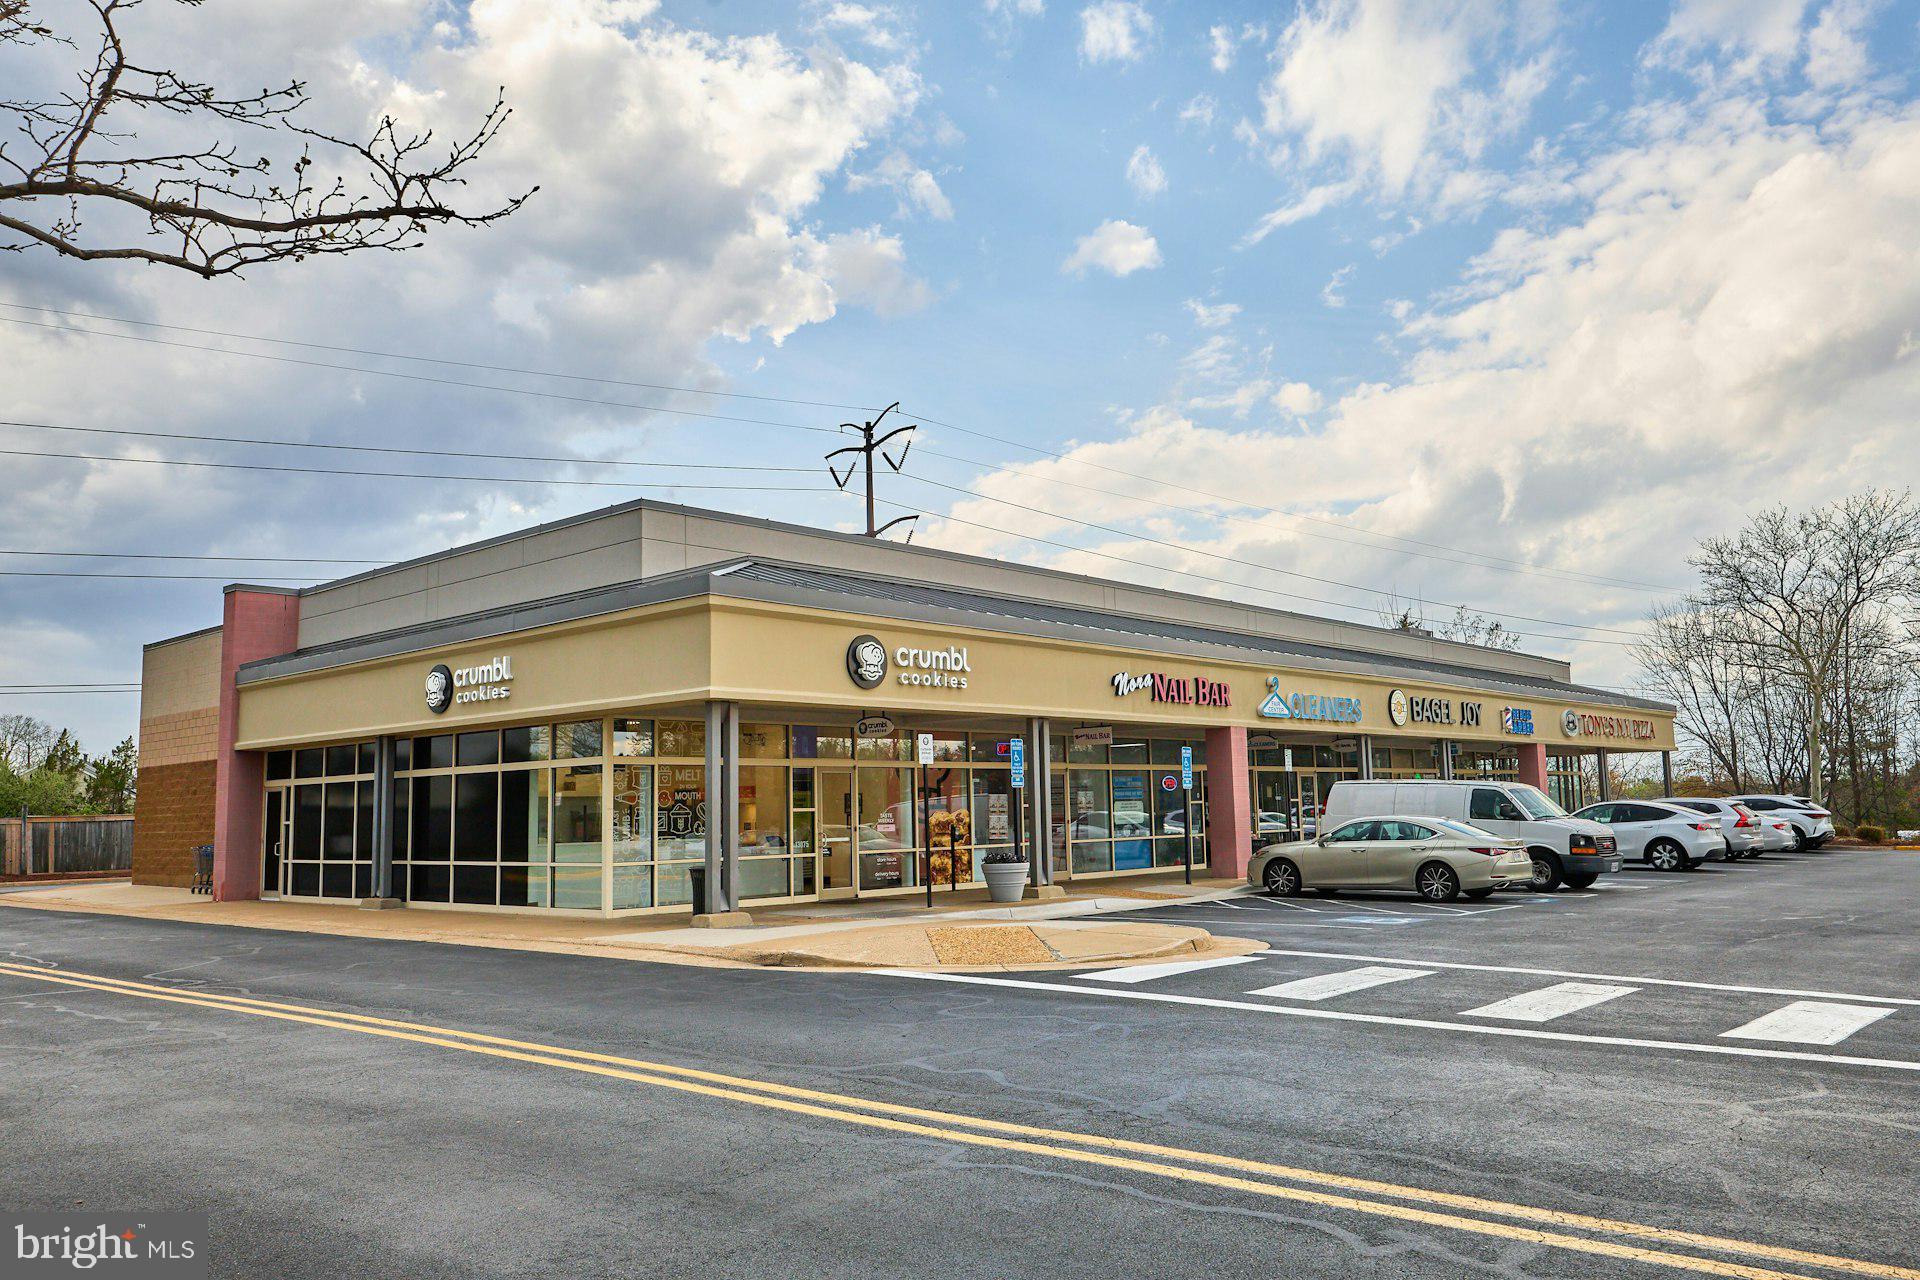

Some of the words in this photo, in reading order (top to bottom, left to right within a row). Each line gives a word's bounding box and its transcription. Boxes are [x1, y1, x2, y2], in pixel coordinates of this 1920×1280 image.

[896, 646, 971, 672] crumbl
[453, 656, 513, 688] crumbl
[899, 671, 968, 688] cookies
[456, 685, 510, 704] cookies
[1112, 672, 1153, 696] Nora
[1151, 672, 1193, 705] NAIL
[1195, 677, 1232, 706] BAR
[1289, 692, 1363, 722] CLEANERS
[1410, 697, 1456, 724] BAGEL
[1460, 702, 1482, 725] JOY
[1631, 720, 1656, 739] PIZZA
[675, 769, 701, 781] MELT
[675, 791, 702, 800] MOUTH
